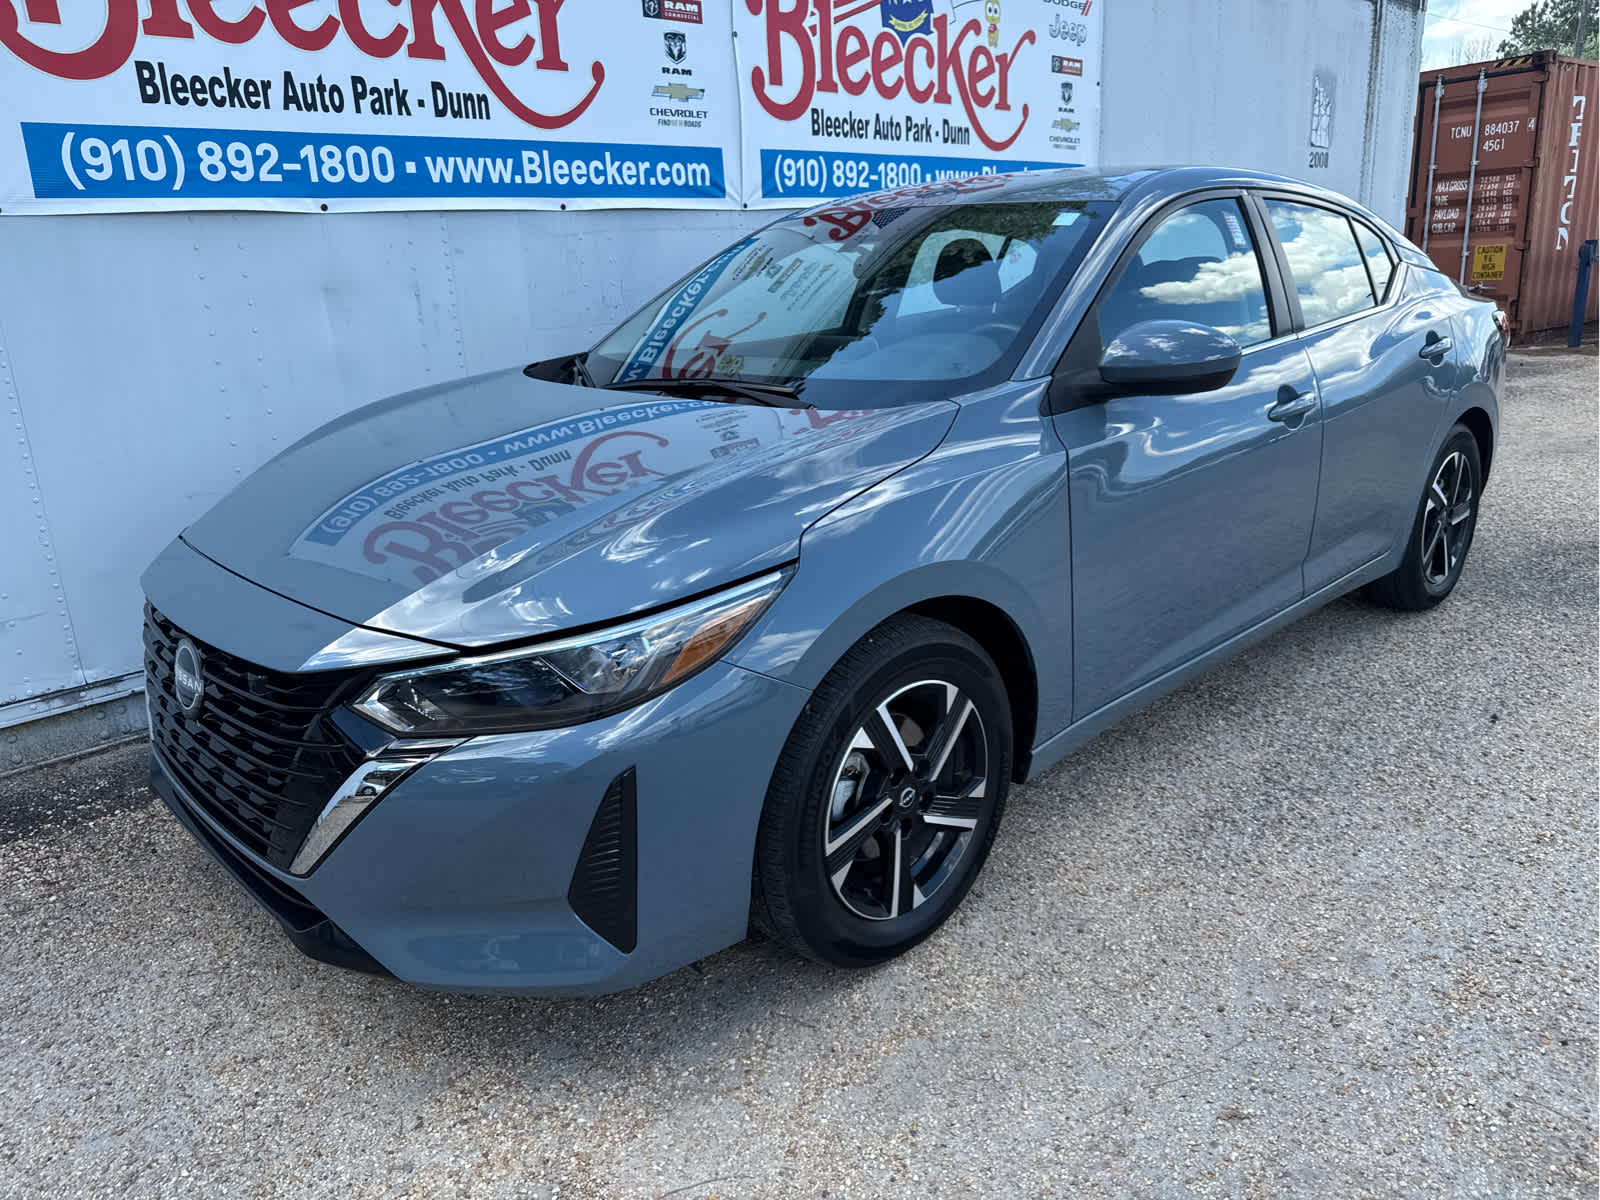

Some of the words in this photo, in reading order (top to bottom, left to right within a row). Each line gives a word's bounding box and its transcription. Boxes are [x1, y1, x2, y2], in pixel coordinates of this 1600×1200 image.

[664, 0, 699, 12] RAM
[1049, 13, 1087, 47] Jeep
[662, 67, 692, 76] RAM
[134, 60, 272, 110] Bleecker
[282, 71, 345, 115] Auto
[351, 75, 412, 117] Park
[431, 81, 491, 120] Dunn
[650, 107, 709, 120] CHEVROLET
[811, 108, 870, 139] Bleecker
[873, 113, 902, 141] Auto
[905, 118, 932, 144] Park
[942, 119, 970, 145] Dunn
[1451, 126, 1472, 140] TCNU
[1484, 120, 1520, 136] 884037
[1483, 138, 1504, 152] 45G1
[60, 131, 186, 190] (910)
[199, 140, 395, 184] 892-1800
[426, 148, 711, 187] www.Bleecker.com
[774, 154, 827, 193] (910)
[833, 160, 921, 189] 892-1800
